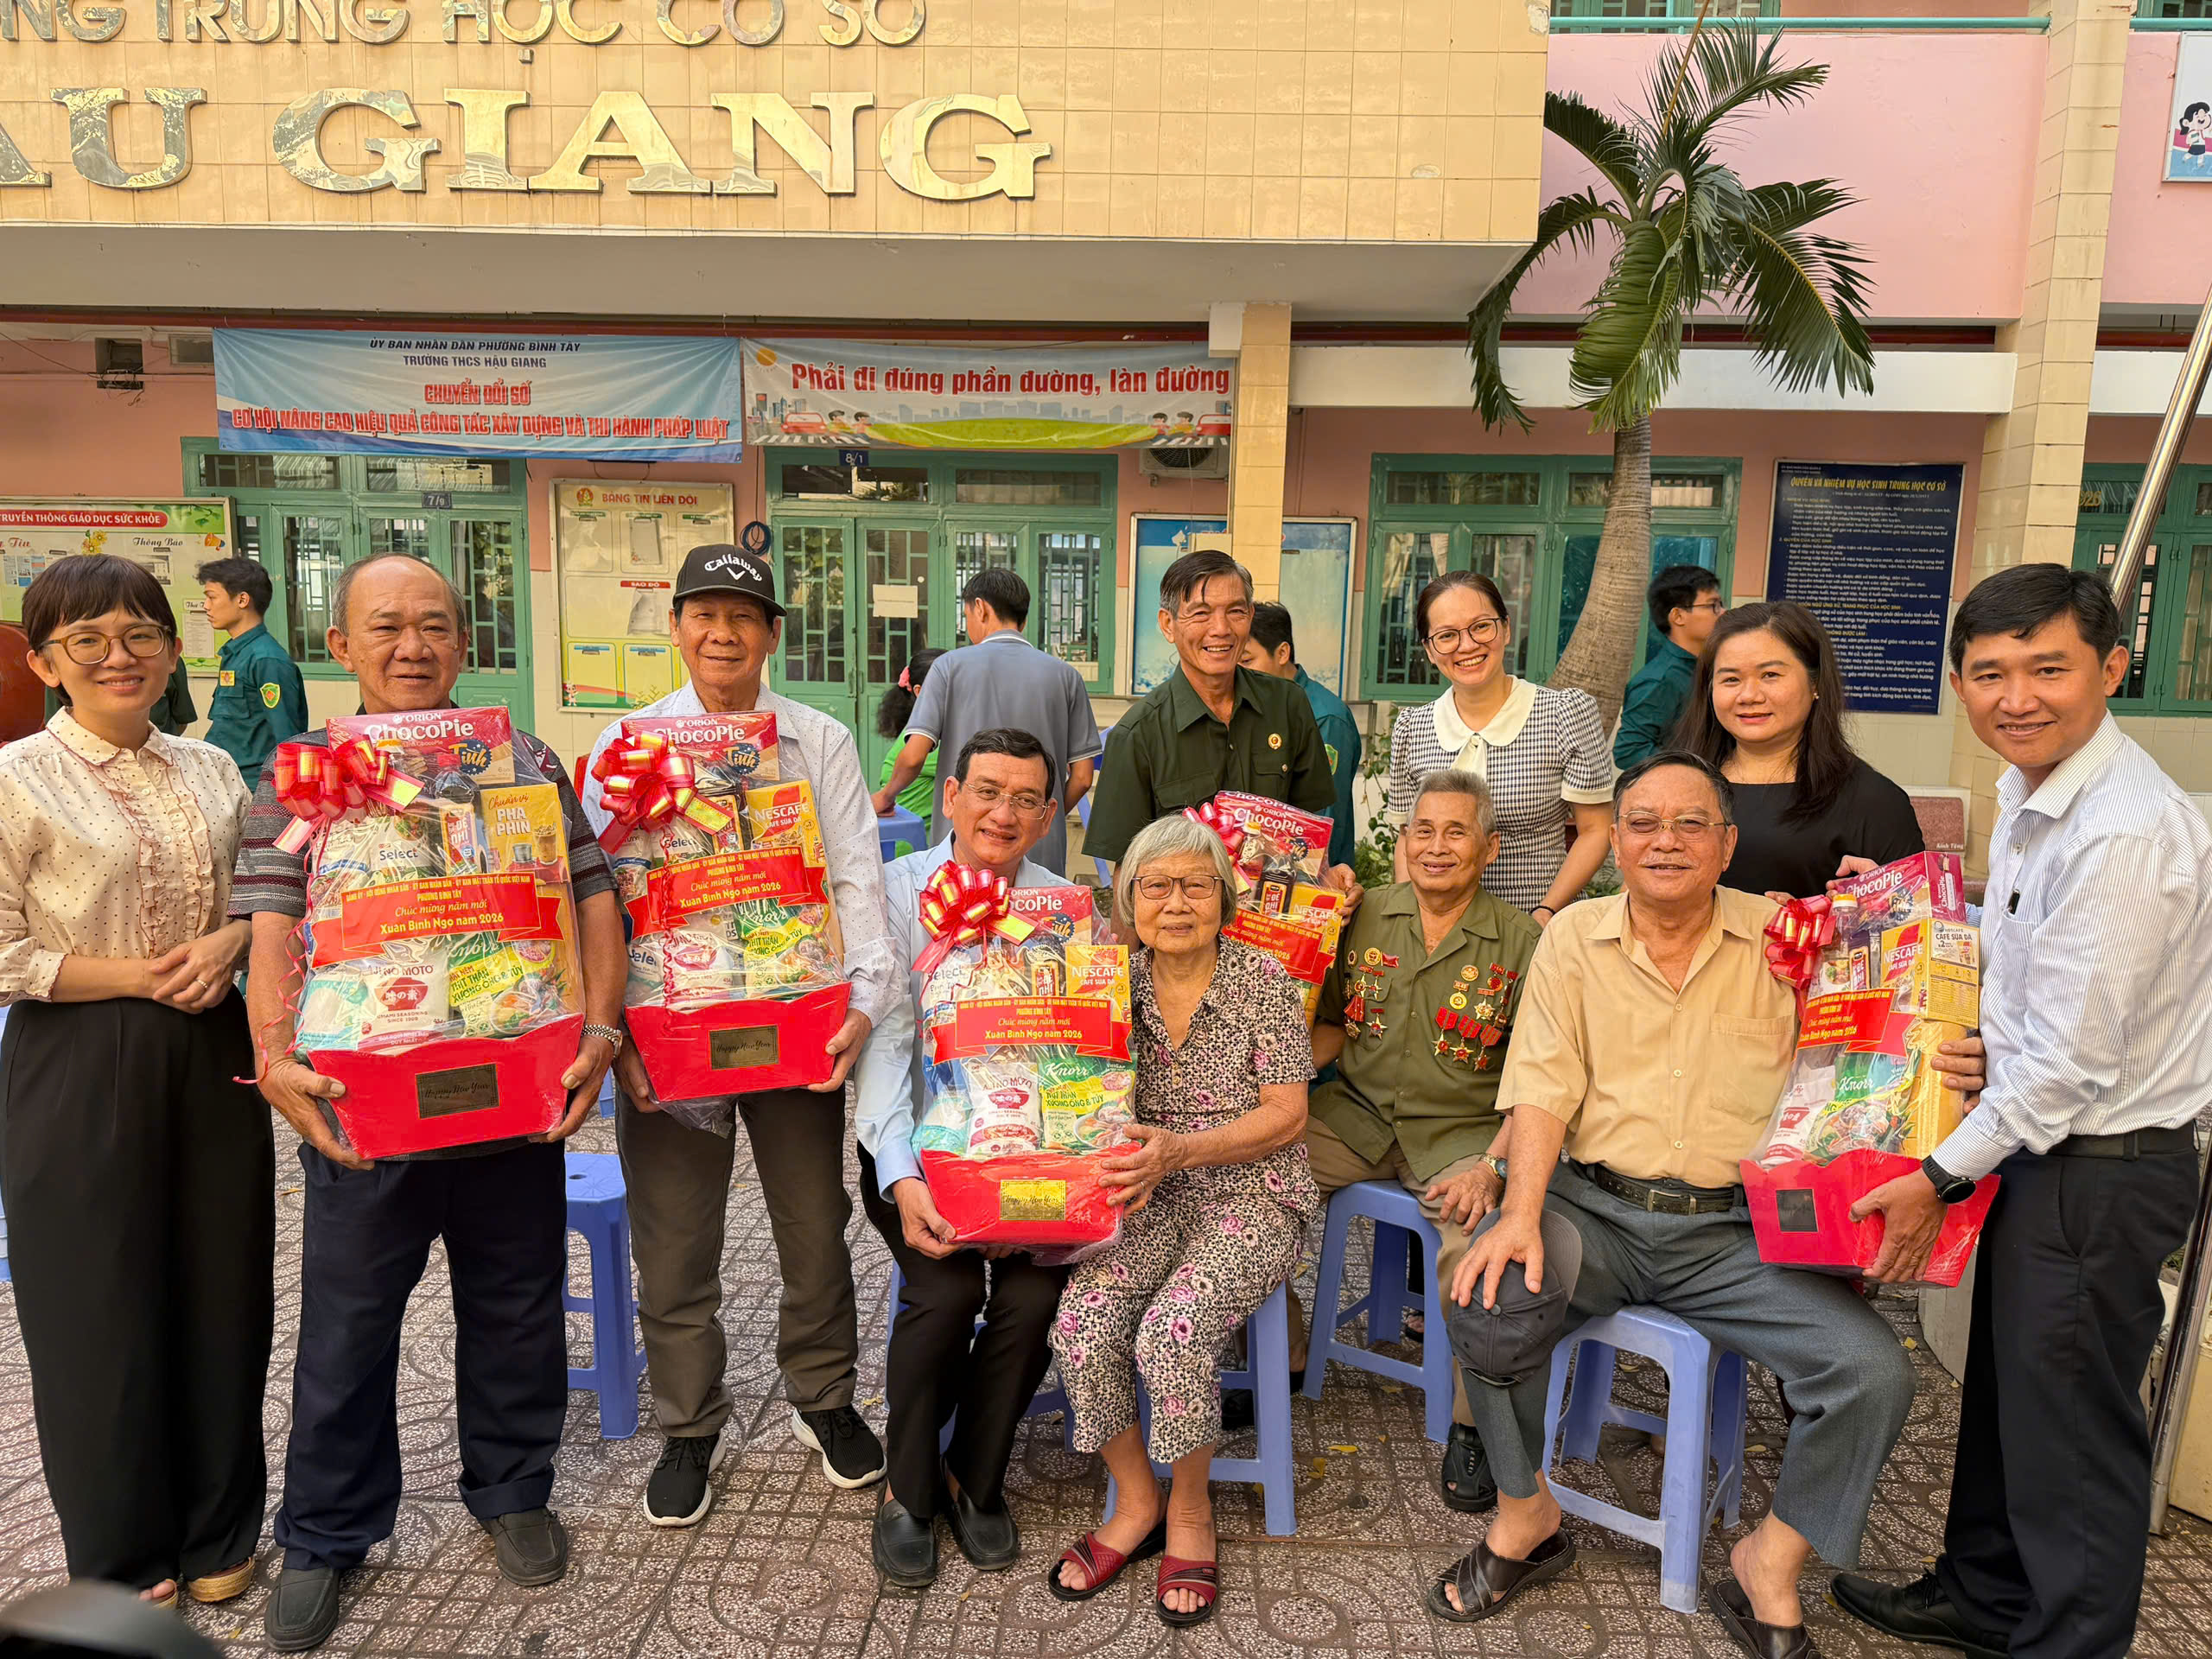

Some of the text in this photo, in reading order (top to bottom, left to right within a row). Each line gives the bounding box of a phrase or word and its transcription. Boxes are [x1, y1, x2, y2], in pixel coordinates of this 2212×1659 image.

[272, 87, 1052, 200] GIANG
[388, 340, 412, 350] BAN
[415, 338, 448, 351] NHÂN
[451, 339, 474, 351] DÂN
[478, 340, 525, 352] PHƯỜNG
[529, 339, 556, 352] BÌNH
[560, 340, 581, 352] TÂY
[403, 354, 546, 370] TRƯỜNG THCS HẬU GIANG
[791, 361, 1230, 397] Phải đi đúng phần đường, làn đường
[424, 378, 531, 405] CHUYỂN ĐỔI SỐ
[232, 407, 731, 444] CƠ HỘI NÂNG CAO HIỆU QUẢ CÔNG TÁC XÂY DỰNG VÀ THI HÀNH PHÁP LUẬT
[845, 452, 863, 464] 8/1
[634, 494, 650, 504] TIN
[69, 512, 92, 524] GIÁO
[93, 514, 112, 524] DỤC
[115, 513, 133, 524] SỨC
[704, 553, 762, 582] Callaway
[405, 713, 442, 723] ORION
[687, 718, 719, 728] ORION
[364, 718, 475, 743] ChocoPie
[496, 807, 526, 822] PHA
[1263, 807, 1287, 818] ORION
[496, 820, 531, 836] PHIN
[1234, 808, 1304, 836] ChocoPie
[379, 849, 419, 861] Select
[761, 881, 781, 893] 2026
[1010, 888, 1039, 897] ORION
[395, 905, 417, 917] Chúc
[448, 900, 469, 912] năm
[471, 899, 487, 910] mới
[480, 912, 504, 925] 2026
[1063, 1029, 1083, 1039] 2026
[1045, 1062, 1090, 1077] Knorr
[1840, 1076, 1873, 1091] Knorr
